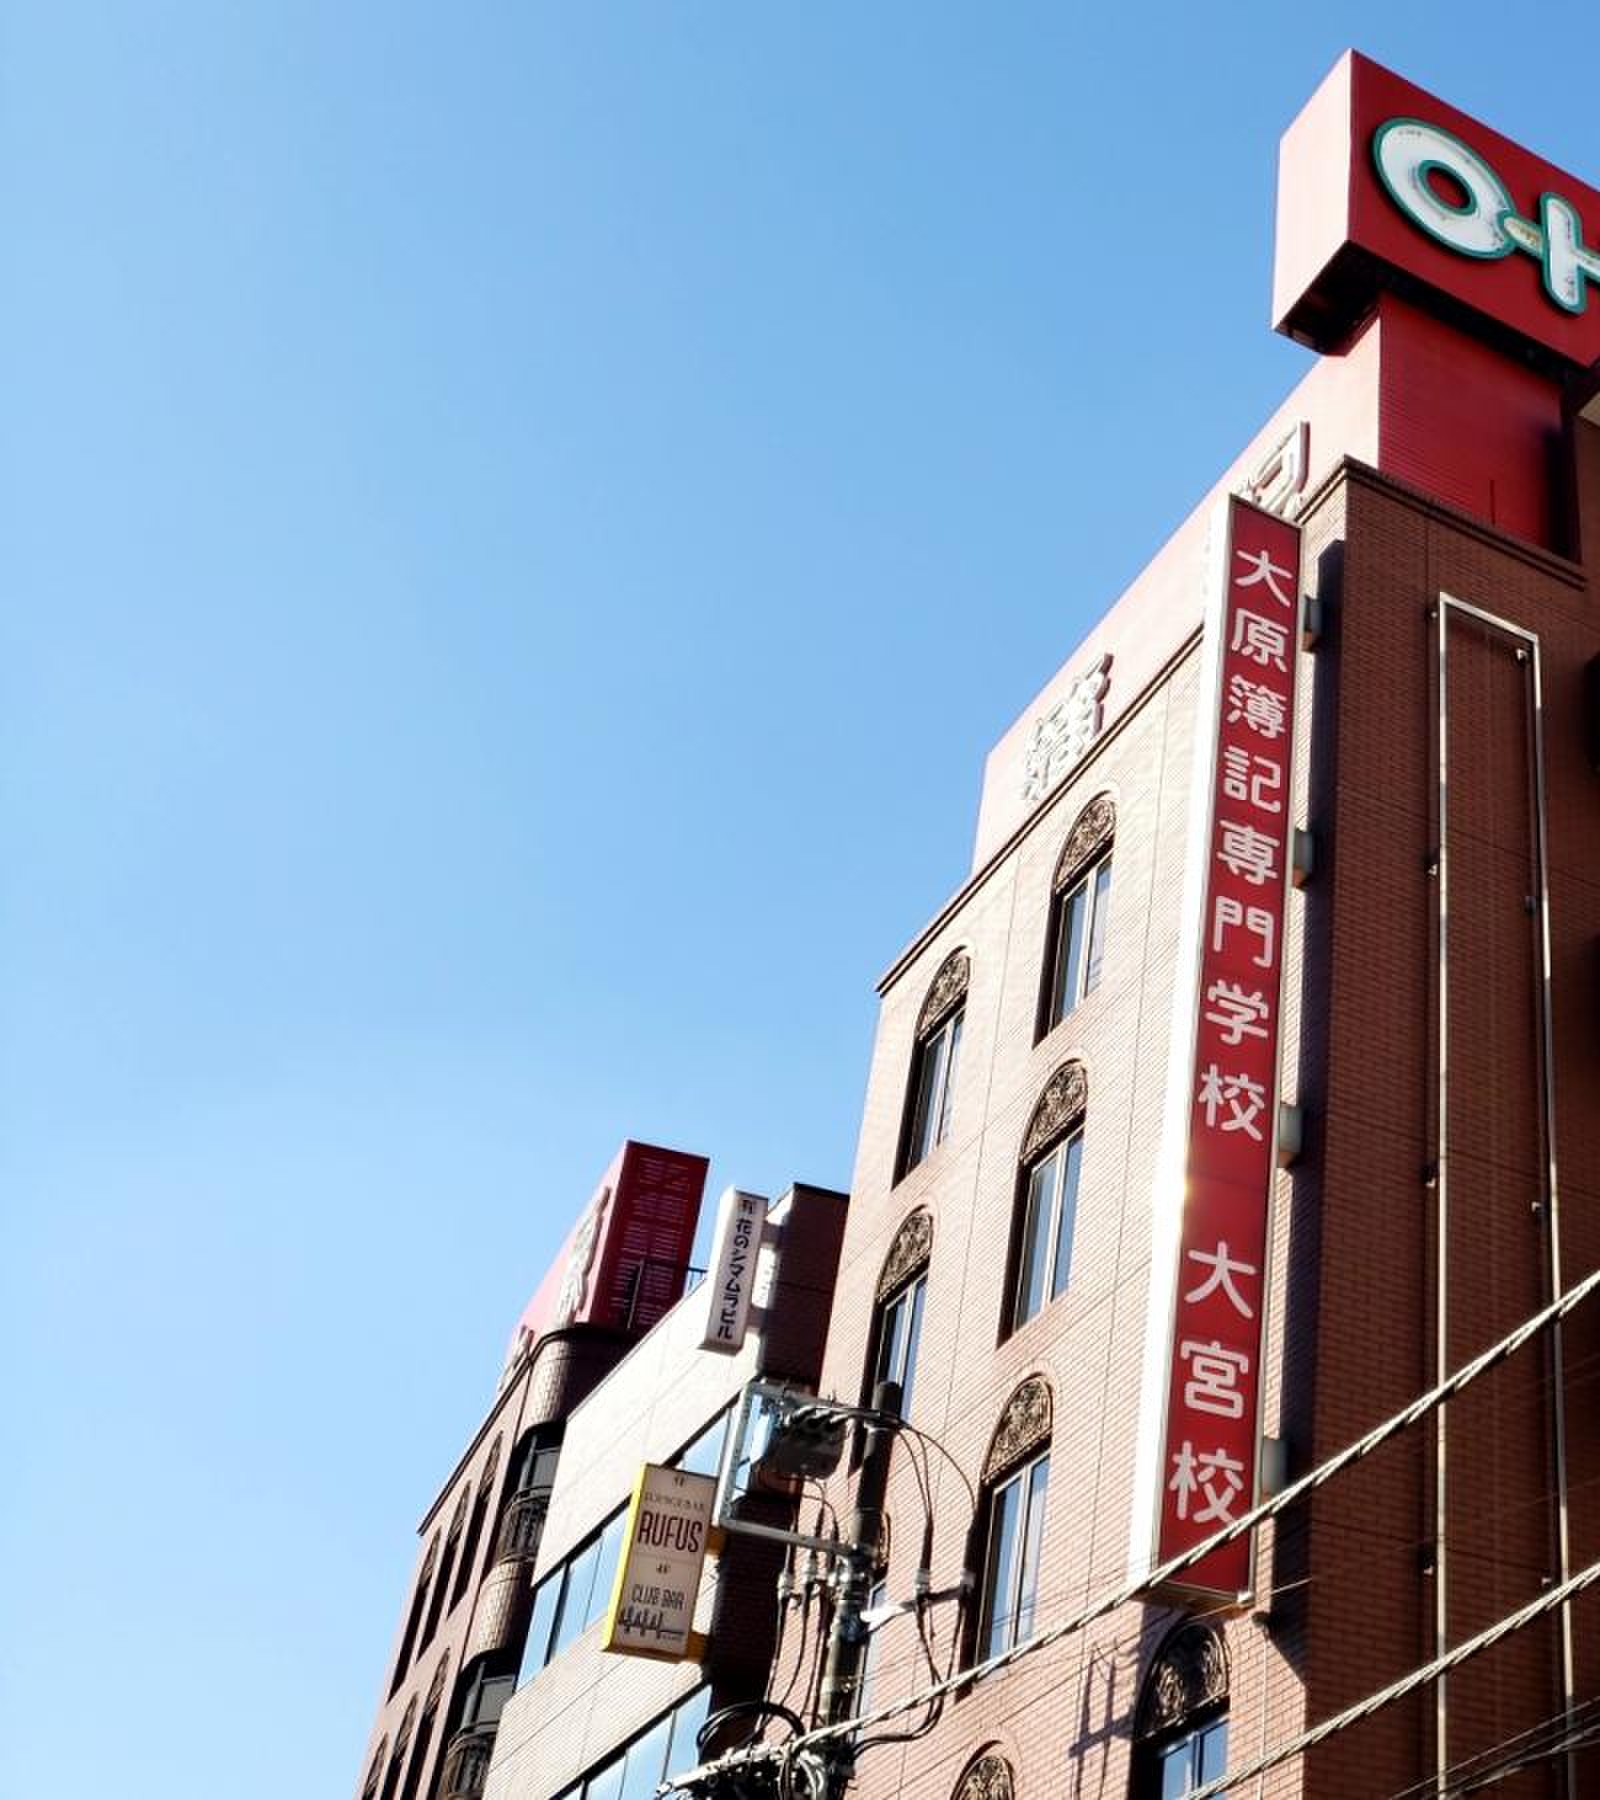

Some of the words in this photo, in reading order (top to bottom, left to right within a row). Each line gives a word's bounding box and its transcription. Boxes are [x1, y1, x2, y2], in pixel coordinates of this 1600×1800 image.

[1198, 549, 1294, 1142] 大原簿記専門学校
[1168, 1240, 1257, 1526] 大宮校
[637, 1510, 703, 1553] RUFUS
